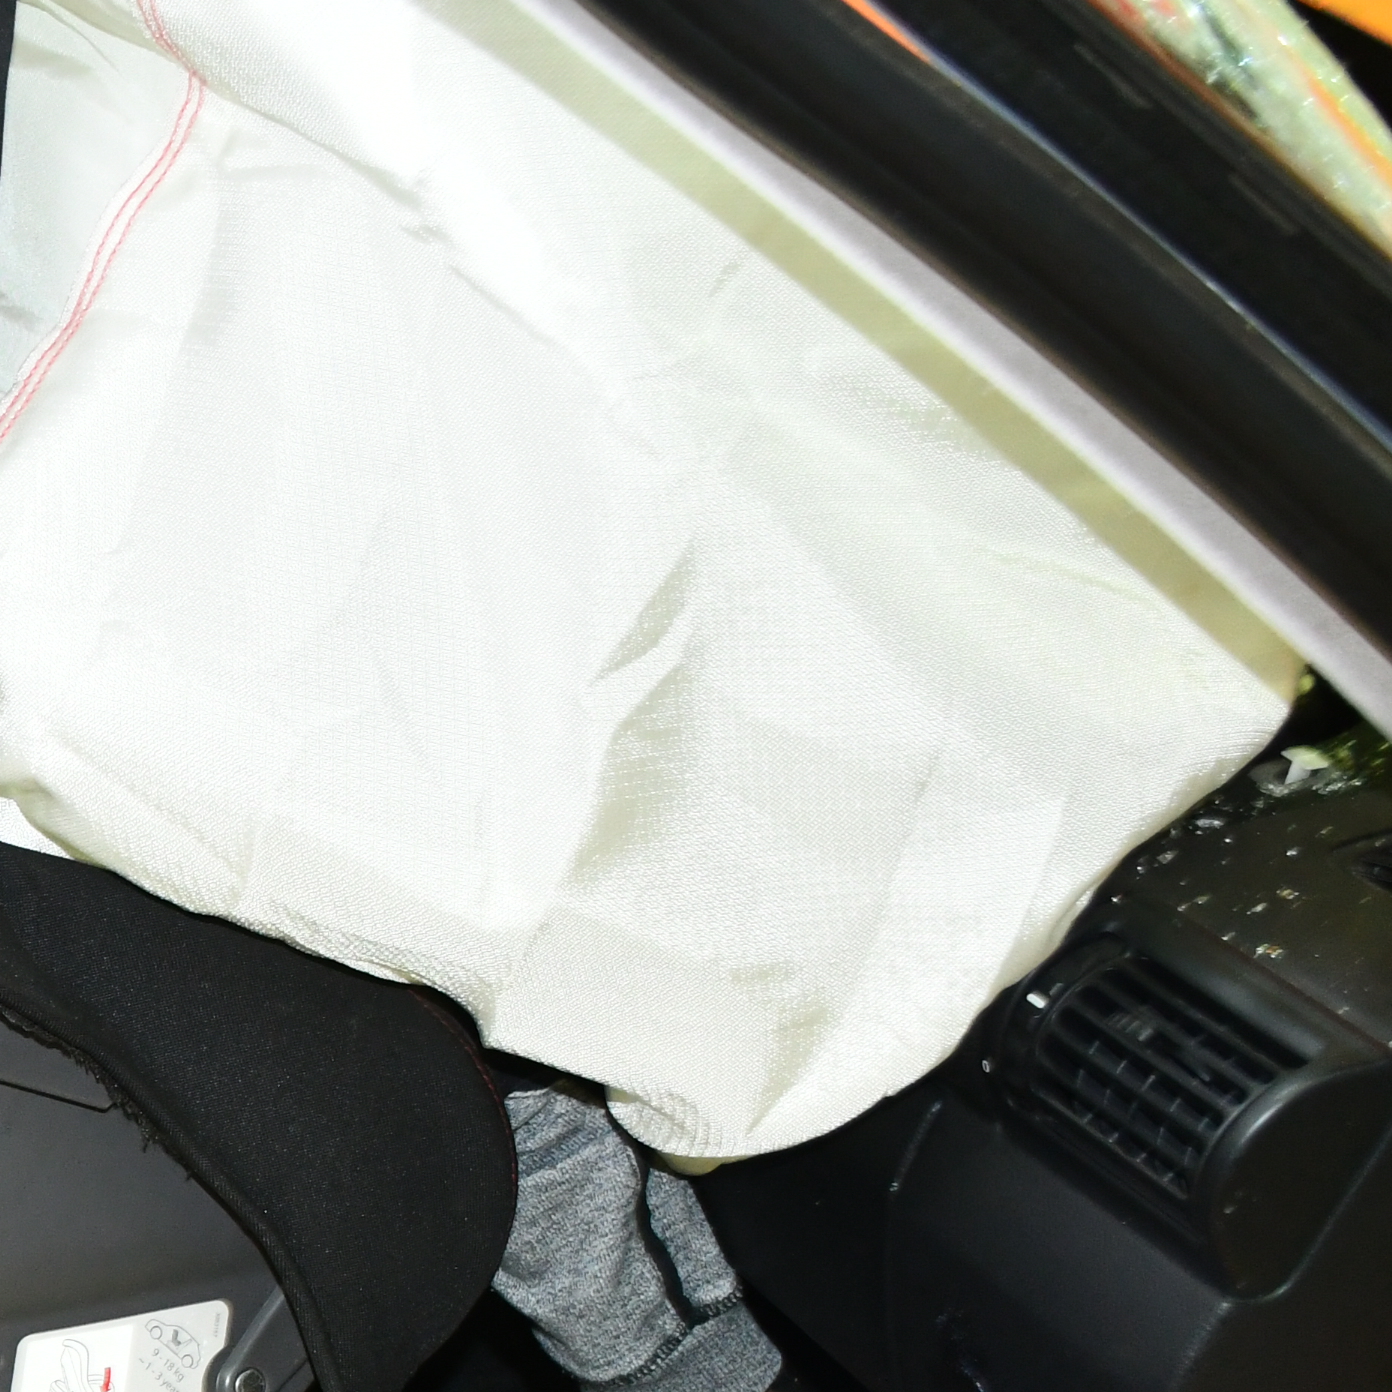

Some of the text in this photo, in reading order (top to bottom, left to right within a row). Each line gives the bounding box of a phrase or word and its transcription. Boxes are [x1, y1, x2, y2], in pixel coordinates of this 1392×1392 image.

[151, 1347, 160, 1357] 9
[163, 1358, 175, 1371] 18
[172, 1366, 185, 1383] kg
[154, 1371, 163, 1380] 3
